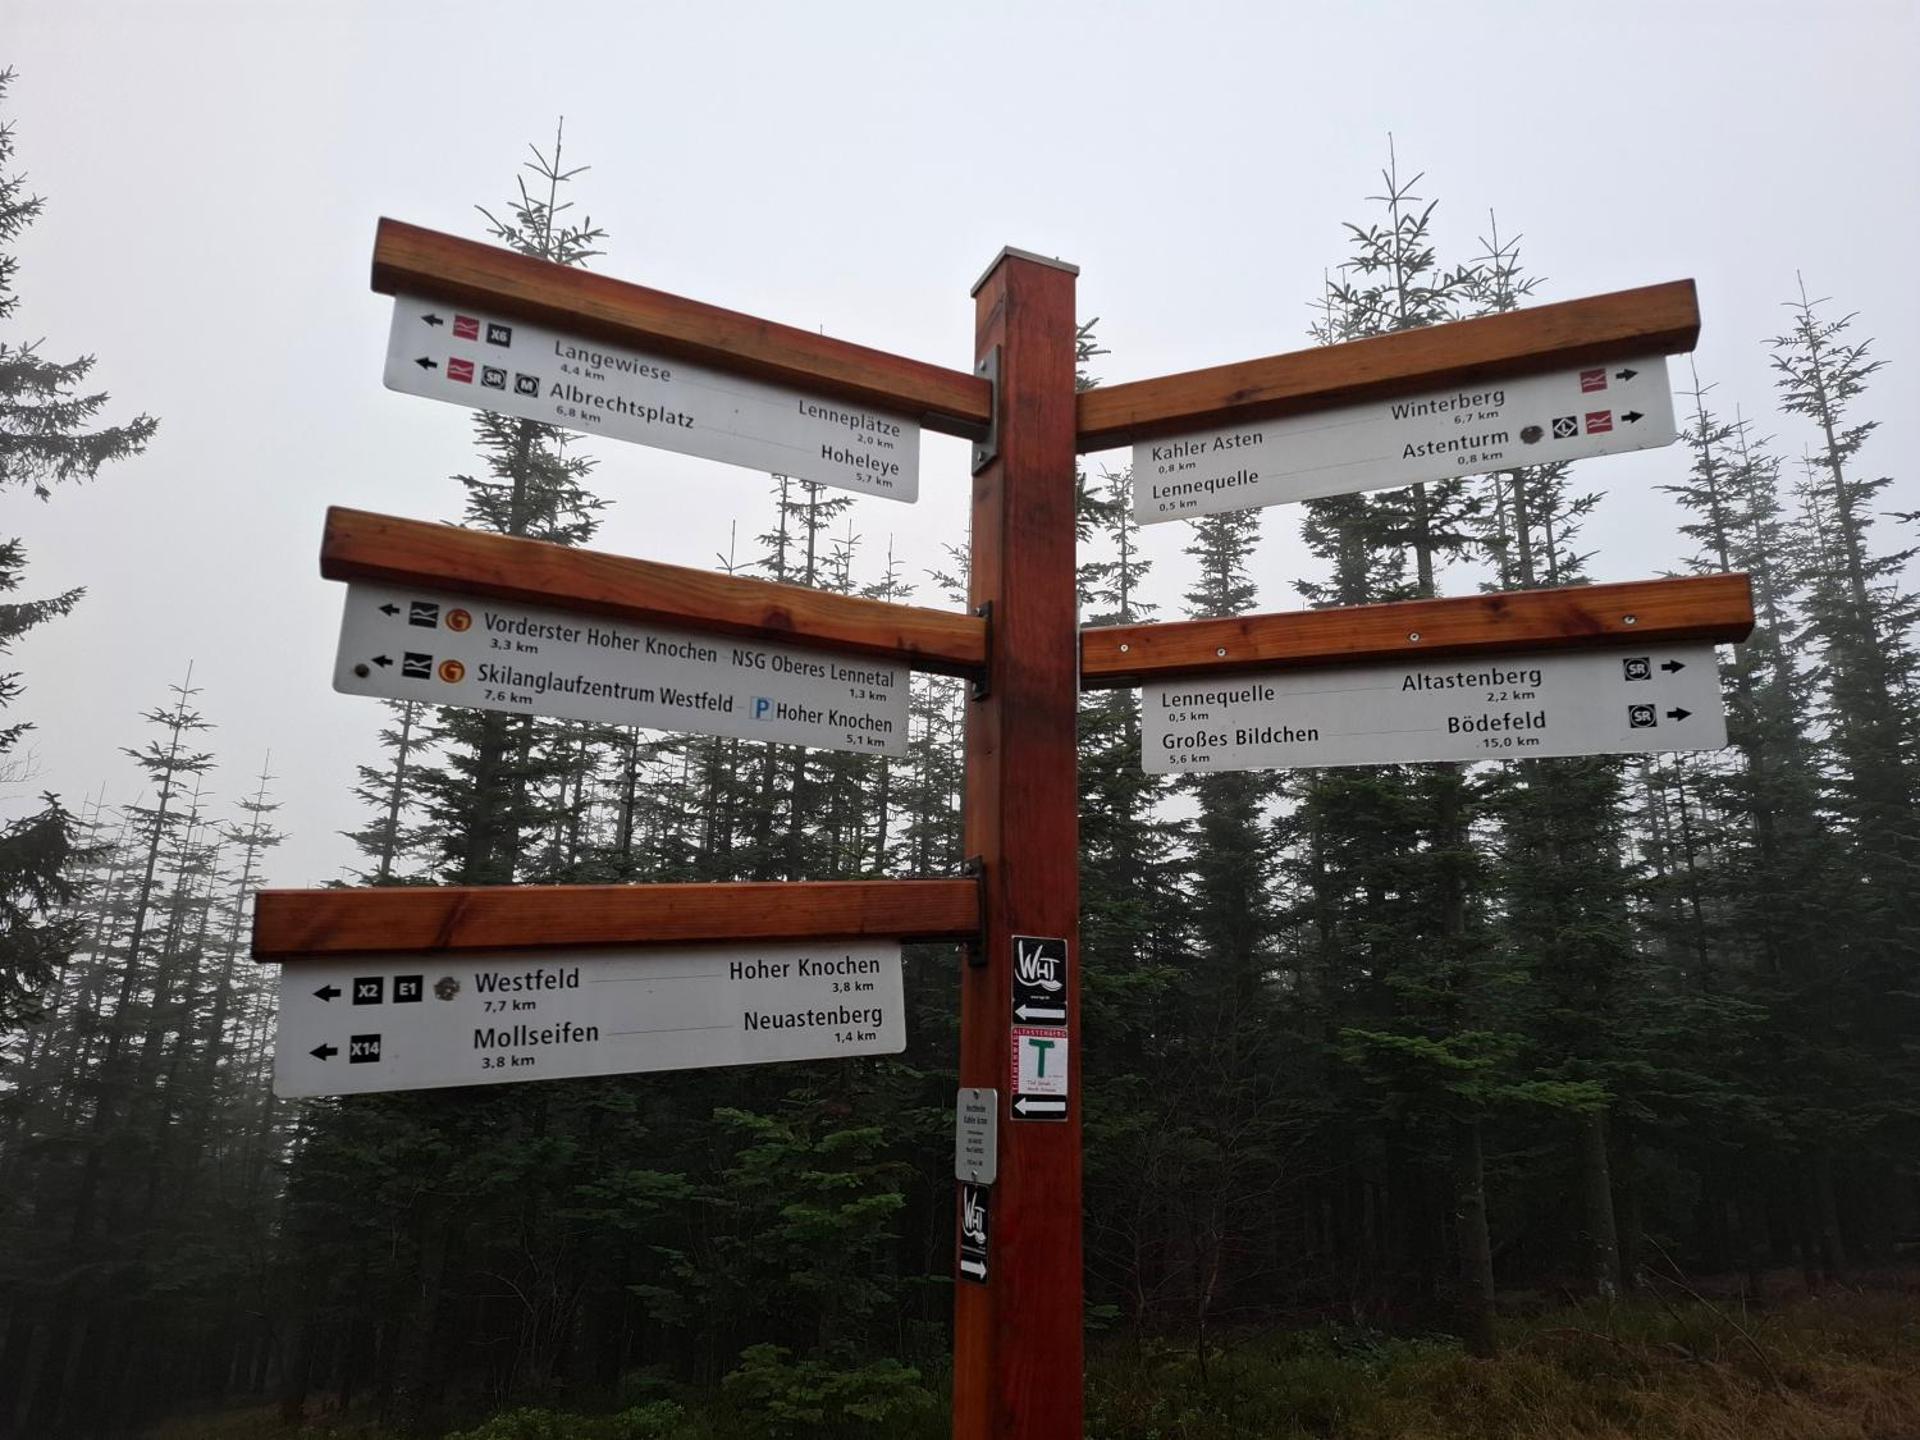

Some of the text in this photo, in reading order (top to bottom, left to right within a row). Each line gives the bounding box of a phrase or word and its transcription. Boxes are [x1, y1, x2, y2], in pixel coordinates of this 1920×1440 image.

[490, 330, 507, 343] X6
[555, 341, 671, 382] Langewiese
[585, 369, 604, 381] km
[551, 382, 694, 429] Albrechtsplatz
[1392, 390, 1505, 420] Winterberg
[581, 411, 601, 423] km
[800, 400, 900, 437] Lenneplätze
[1454, 410, 1499, 425] 6,7 km
[857, 434, 893, 449] 2,0 km
[1152, 432, 1263, 461] Kahler Asten
[1402, 430, 1509, 459] Astenturm
[822, 445, 899, 476] Hoheleye
[1458, 451, 1502, 465] 0,8 km
[1159, 461, 1196, 475] 0,8 km
[876, 477, 892, 488] km
[1153, 470, 1259, 500] Lennequelle
[1160, 498, 1197, 512] 0,5 km
[485, 613, 717, 662] Vorderster Hoher Knochen
[516, 641, 538, 654] km
[733, 650, 894, 687] NSG Oberes Lennetal
[1628, 663, 1646, 674] SR
[1402, 668, 1542, 691] Altastenberg
[478, 663, 733, 712] Skilanglaufzentrum Westfeld
[510, 693, 532, 705] km
[870, 690, 886, 701] km
[1162, 685, 1275, 708] Lennequelle
[1487, 690, 1535, 702] 2,2 km
[756, 700, 892, 733] P Hoher Knochen
[1169, 711, 1209, 723] 0,5 km
[1633, 708, 1651, 720] SR
[1449, 711, 1545, 733] Bödefeld
[847, 734, 884, 747] 5,1 km
[1163, 726, 1319, 749] Großes Bildchen
[1483, 736, 1539, 748] 15,0 km
[1170, 753, 1210, 765] 5,6 km
[730, 956, 880, 980] Hoher Knochen
[475, 968, 579, 993] Westfeld
[833, 982, 873, 993] 3,8 km
[359, 984, 377, 997] X2
[400, 982, 416, 995] E1
[513, 998, 536, 1010] km
[744, 1005, 882, 1030] Neuastenberg
[474, 1022, 598, 1049] Mollseifen
[835, 1031, 876, 1043] 1,4 km
[351, 1042, 380, 1055] X14
[512, 1054, 535, 1066] km
[1029, 1038, 1055, 1077] T
